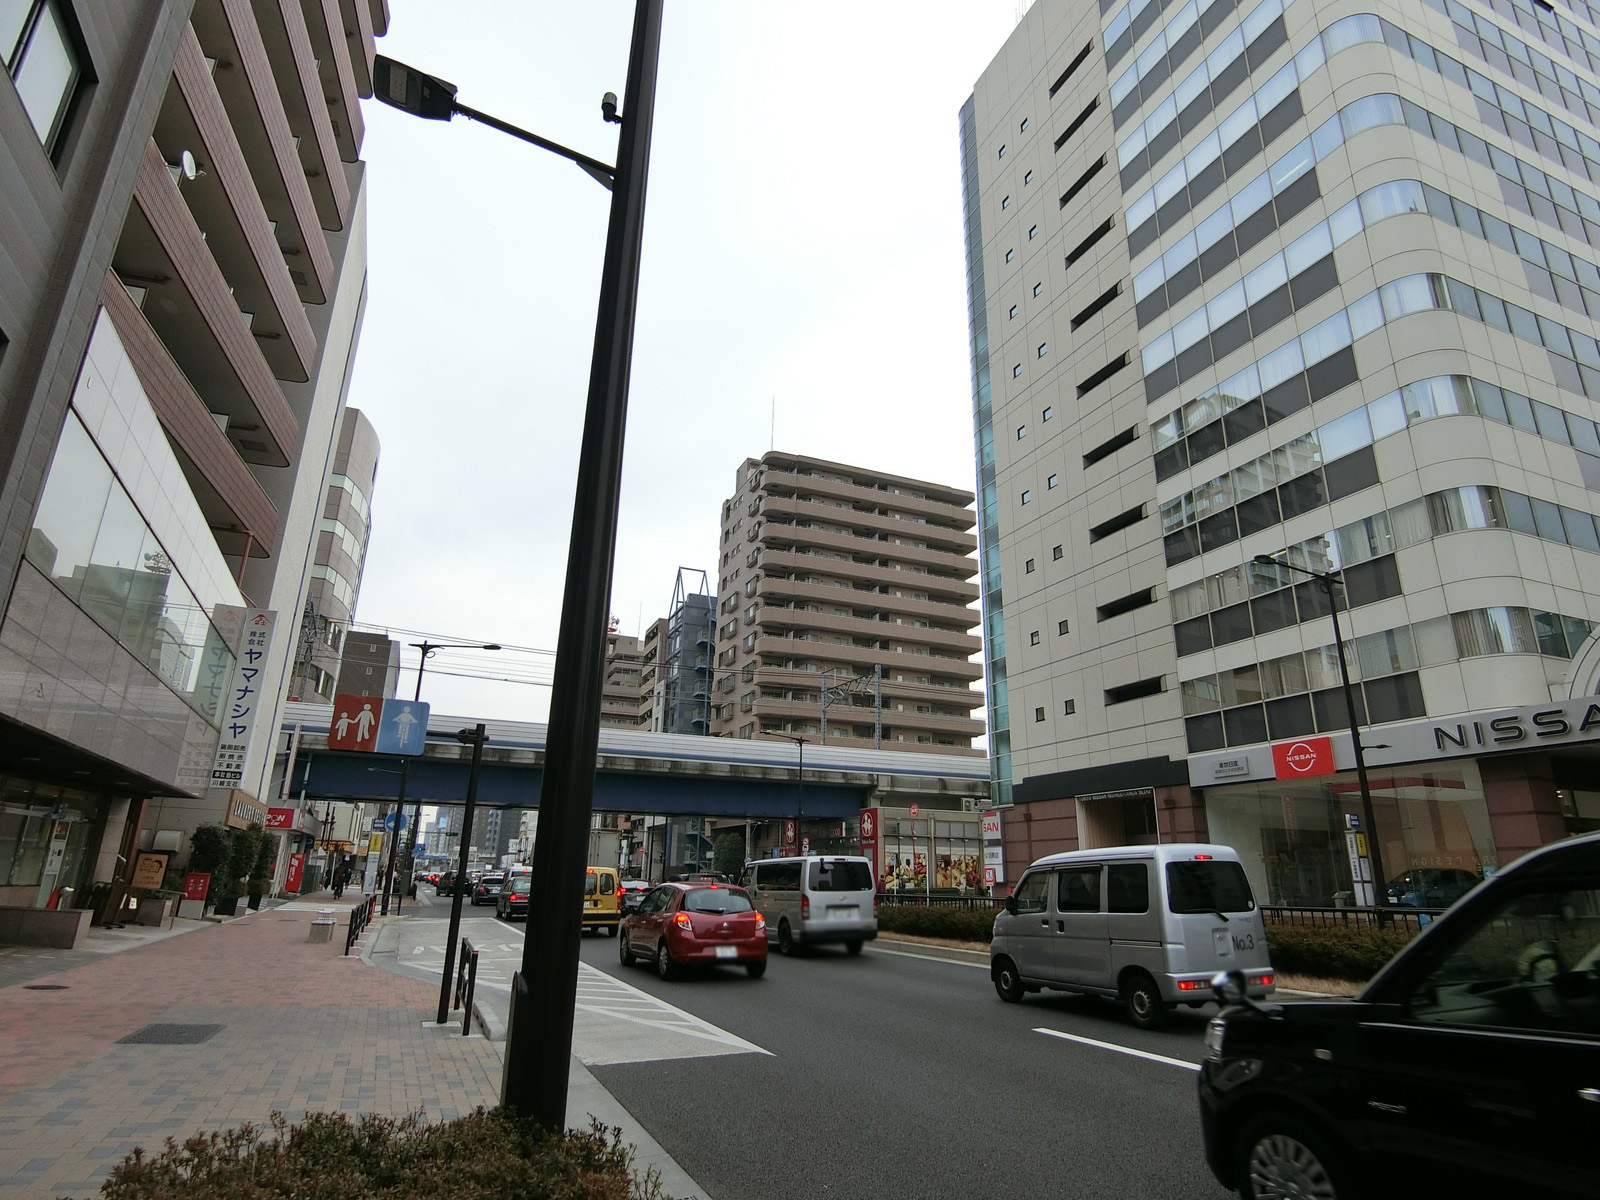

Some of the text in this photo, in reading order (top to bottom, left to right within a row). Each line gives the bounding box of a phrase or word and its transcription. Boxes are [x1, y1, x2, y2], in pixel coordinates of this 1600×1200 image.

[228, 648, 263, 739] ヤマナシヤ
[1286, 752, 1317, 762] NISSAN
[216, 762, 242, 770] 不動産
[211, 780, 238, 788] 川崎支社
[1231, 934, 1254, 951] No.3
